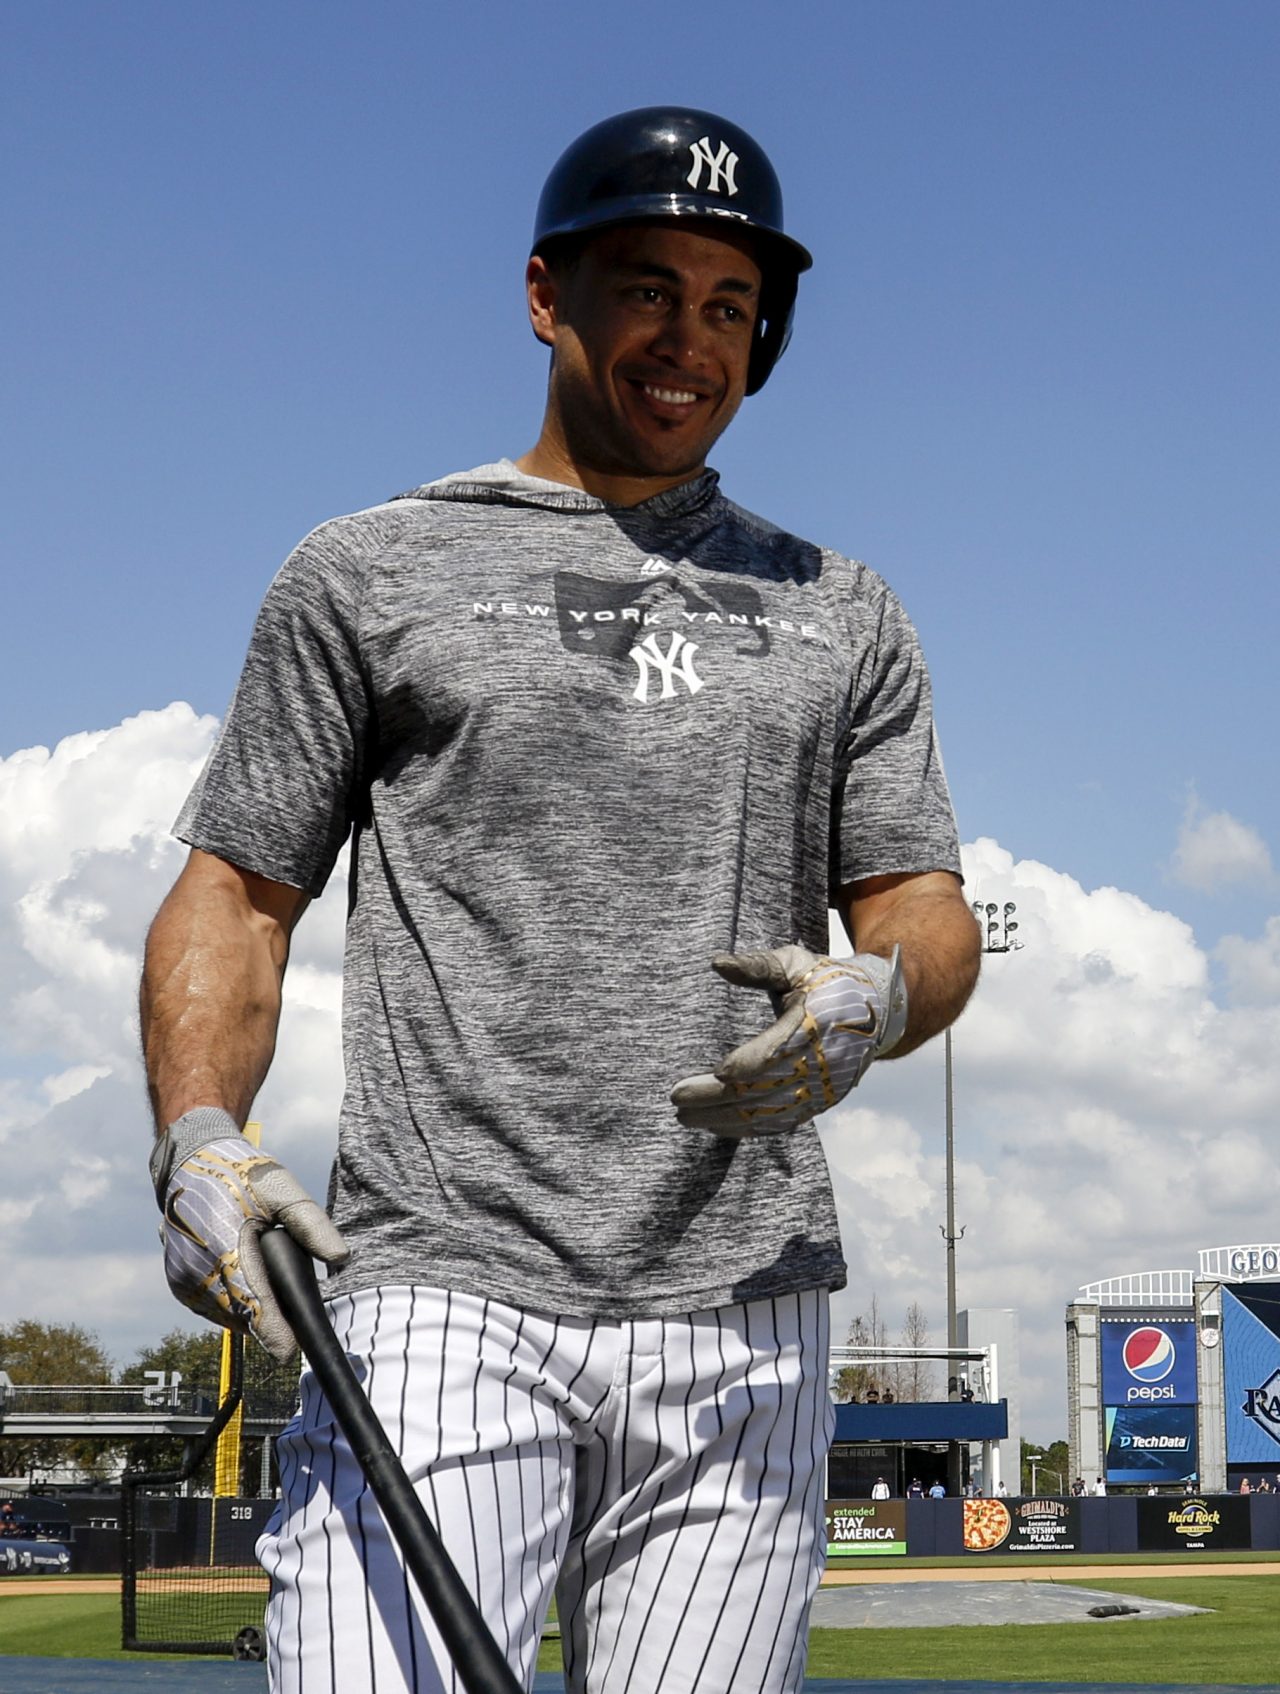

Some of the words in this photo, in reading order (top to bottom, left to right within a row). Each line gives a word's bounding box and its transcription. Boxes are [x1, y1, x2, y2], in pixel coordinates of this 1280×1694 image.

[686, 136, 739, 196] NY
[473, 602, 550, 617] NEW
[569, 607, 661, 626] YORK
[681, 611, 817, 638] YANKEE
[628, 631, 704, 701] NY
[1127, 1384, 1174, 1401] pepsi
[231, 1506, 252, 1520] 318
[833, 1507, 875, 1516] extended
[1168, 1511, 1194, 1523] Hard
[1195, 1510, 1220, 1525] Rock
[833, 1517, 864, 1529] STAY
[1018, 1526, 1067, 1534] WESTSHORE
[833, 1528, 895, 1540] AMERICA
